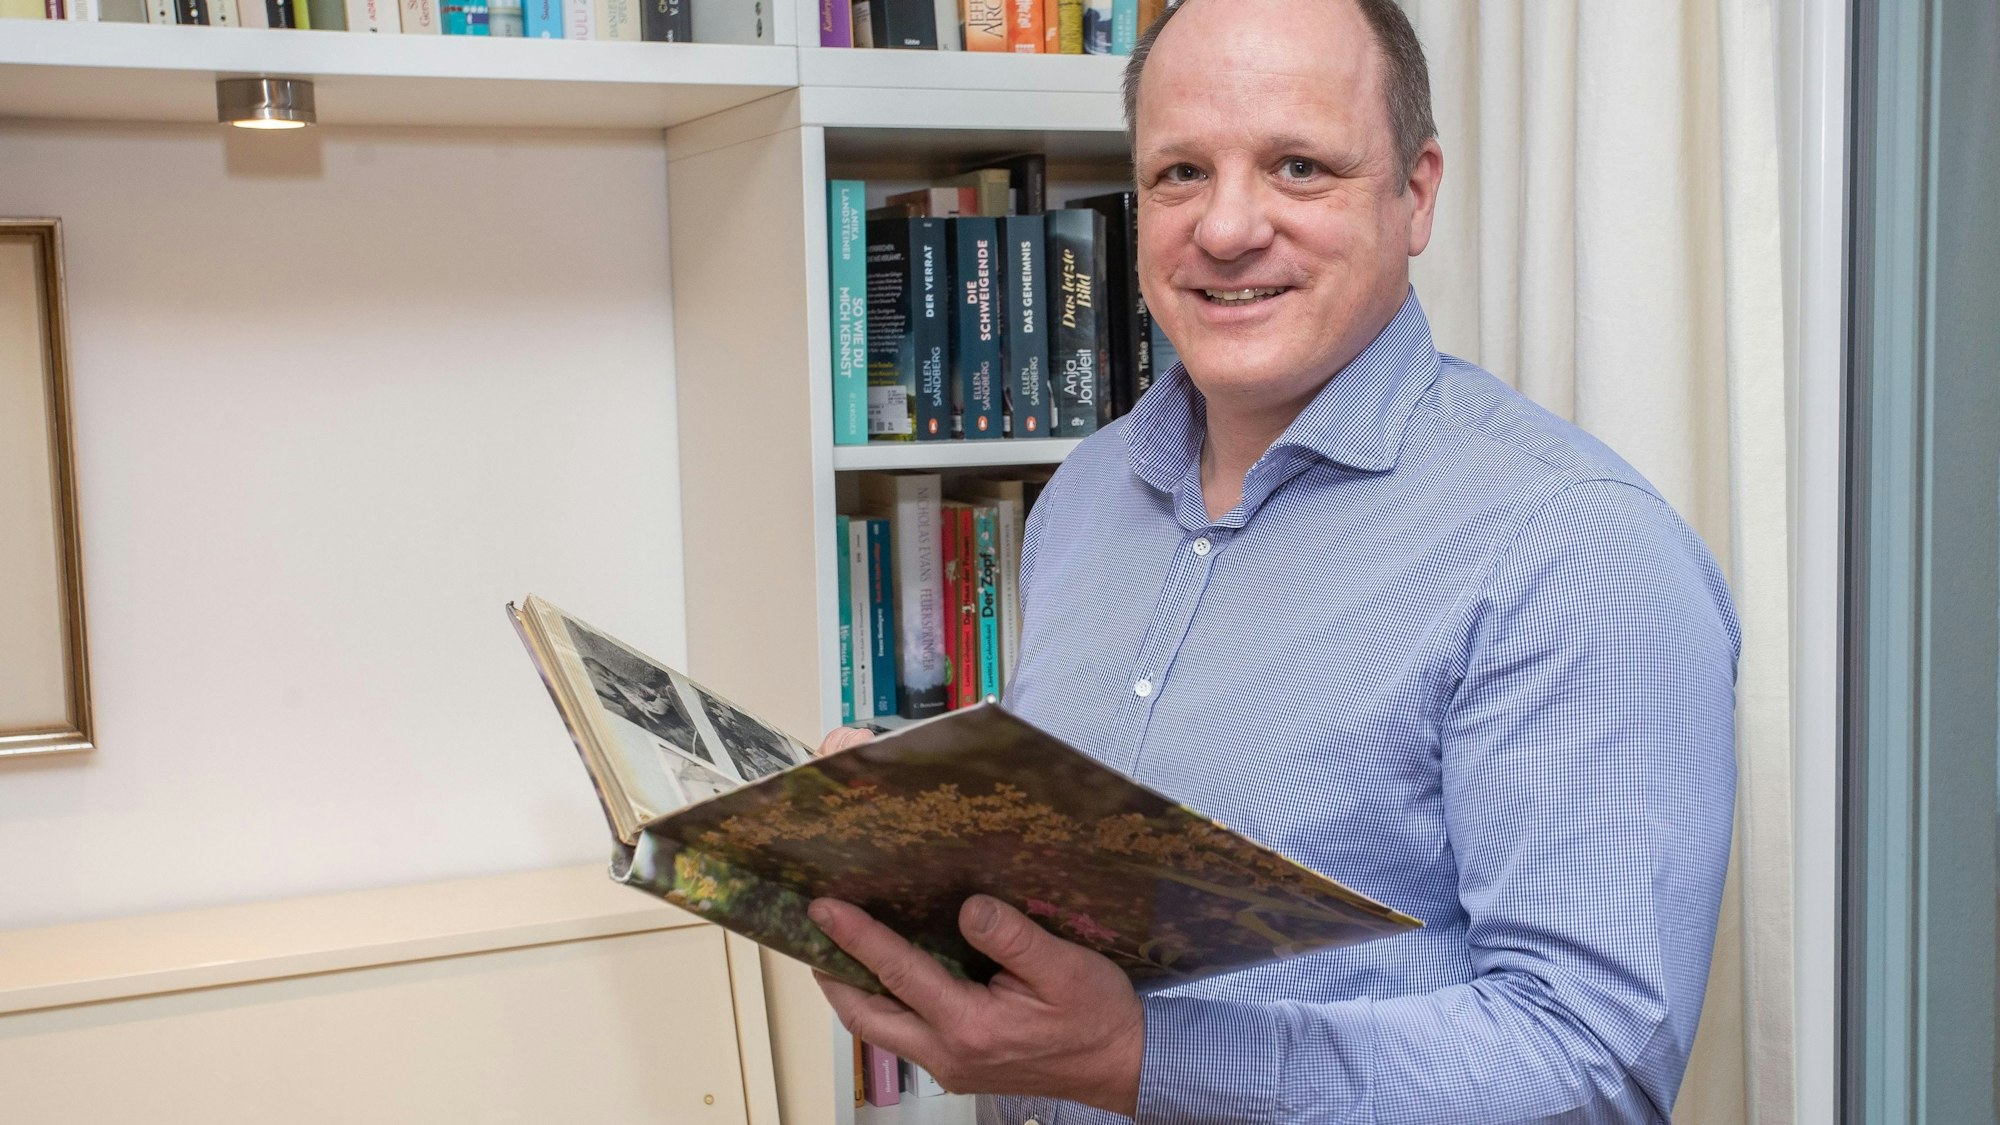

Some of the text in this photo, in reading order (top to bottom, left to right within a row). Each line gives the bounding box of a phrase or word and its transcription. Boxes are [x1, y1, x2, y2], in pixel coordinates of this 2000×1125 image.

[841, 188, 851, 261] LANDSTEINER
[850, 208, 859, 241] ANIKA
[923, 245, 934, 318] DER VERRAT
[966, 281, 978, 304] DIE
[977, 240, 992, 341] SCHWEIGENDE
[1021, 241, 1034, 333] DAS GEHEIMNIS
[1062, 249, 1076, 328] Das letzte
[1076, 273, 1092, 308] Bild
[840, 287, 852, 379] MICH KENNST
[853, 298, 864, 368] SO WIE DU
[1138, 341, 1150, 373] Tieke
[923, 360, 932, 394] ELLEN
[931, 346, 942, 407] SANDBERG
[973, 372, 982, 400] ELLEN
[981, 361, 991, 411] SANDBERG
[1021, 367, 1030, 396] ELLEN
[1029, 356, 1039, 406] SANDBERG
[1063, 359, 1080, 395] Anja
[1076, 349, 1093, 406] Jonuleit
[1139, 374, 1151, 391] W.
[917, 487, 938, 672] NICHOLAS EVANS FEUERSPRINGER
[979, 553, 996, 618] Der Zopf
[985, 623, 994, 688] Laetitia Colombani
